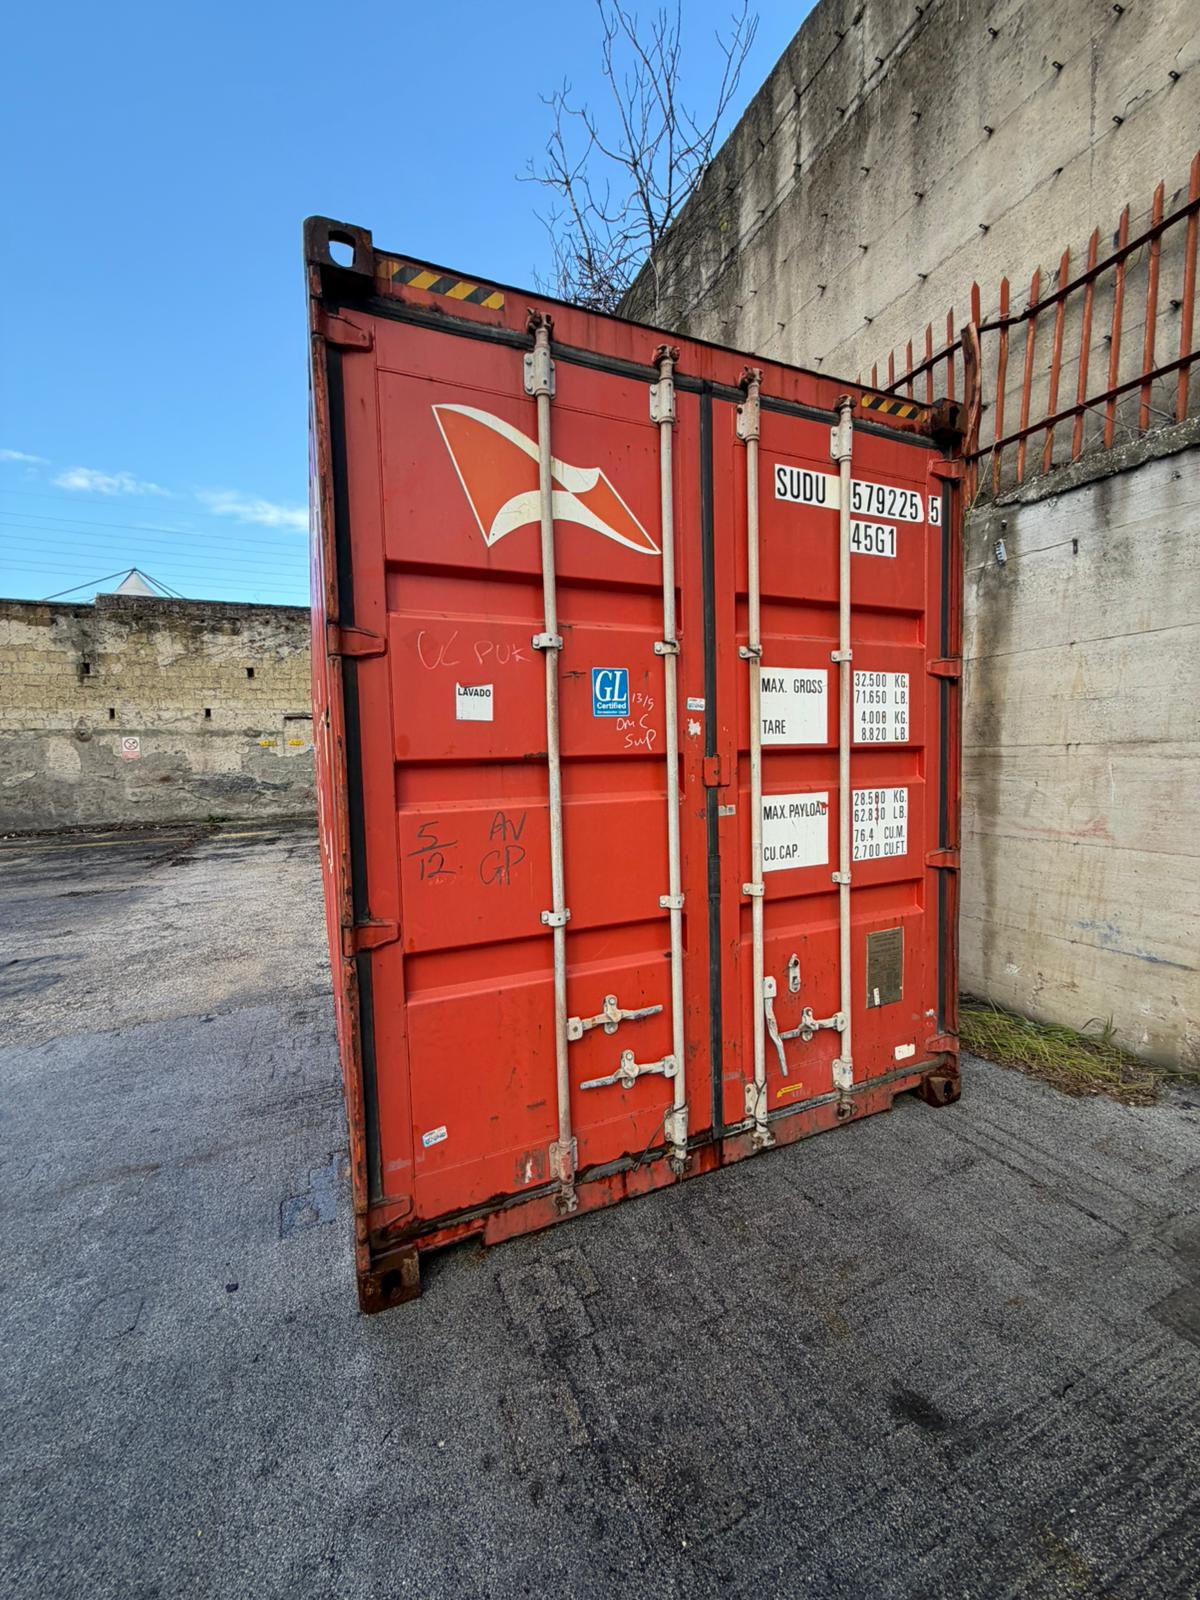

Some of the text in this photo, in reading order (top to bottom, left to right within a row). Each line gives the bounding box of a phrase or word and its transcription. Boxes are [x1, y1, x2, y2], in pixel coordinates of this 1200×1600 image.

[776, 467, 939, 523] SUDU 579225 5
[852, 522, 895, 555] 45G1
[595, 670, 627, 702] GL
[761, 678, 823, 694] MAX. GROSS
[855, 673, 908, 688] 32.500 KG.
[457, 688, 491, 698] LAVADO
[855, 690, 908, 704] 71.650 LB.
[596, 702, 627, 710] Certified
[894, 711, 908, 724] KG.
[762, 719, 786, 735] TARE
[861, 727, 908, 741] 8.820 LB.
[893, 789, 907, 803] KG.
[854, 805, 907, 822] 62.830 LB.
[854, 827, 874, 843] 76.4
[854, 843, 880, 859] 2.700
